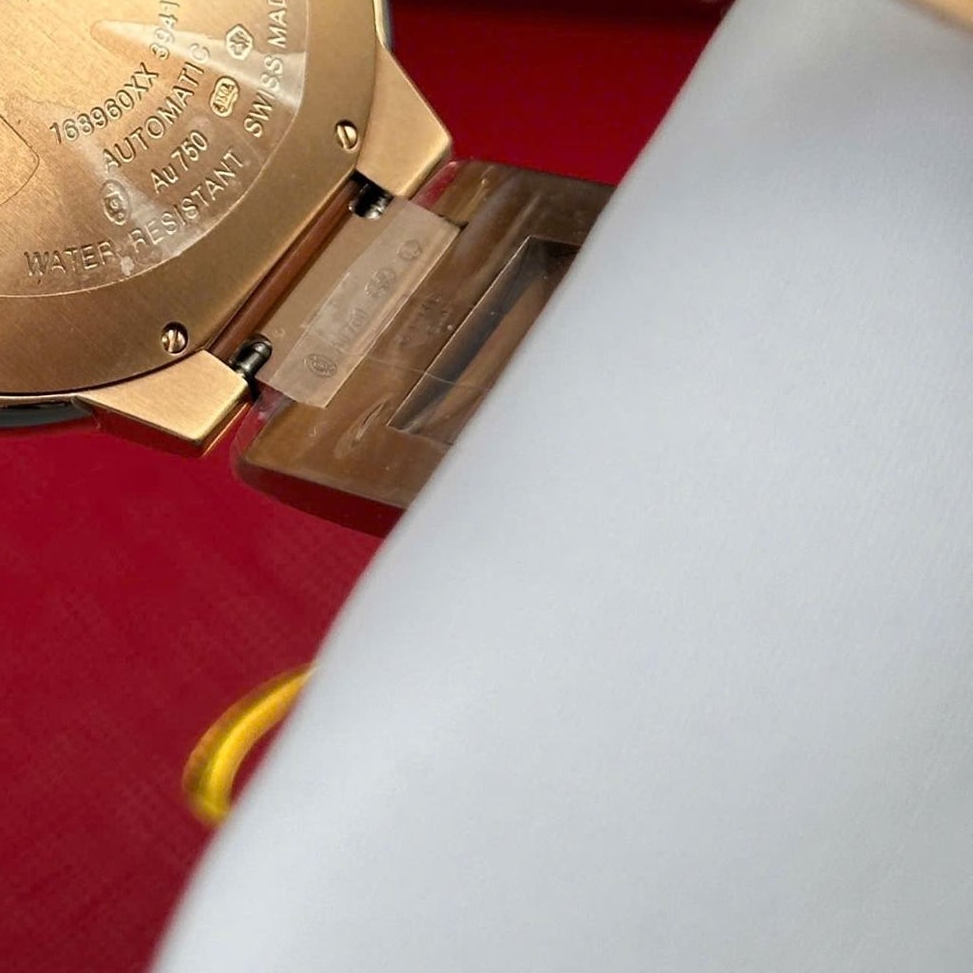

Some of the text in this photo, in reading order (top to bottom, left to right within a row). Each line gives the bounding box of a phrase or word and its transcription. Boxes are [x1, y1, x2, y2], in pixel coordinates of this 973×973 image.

[102, 42, 211, 174] AUTOMATIC
[242, 54, 284, 138] SWISS
[170, 129, 210, 173] 750
